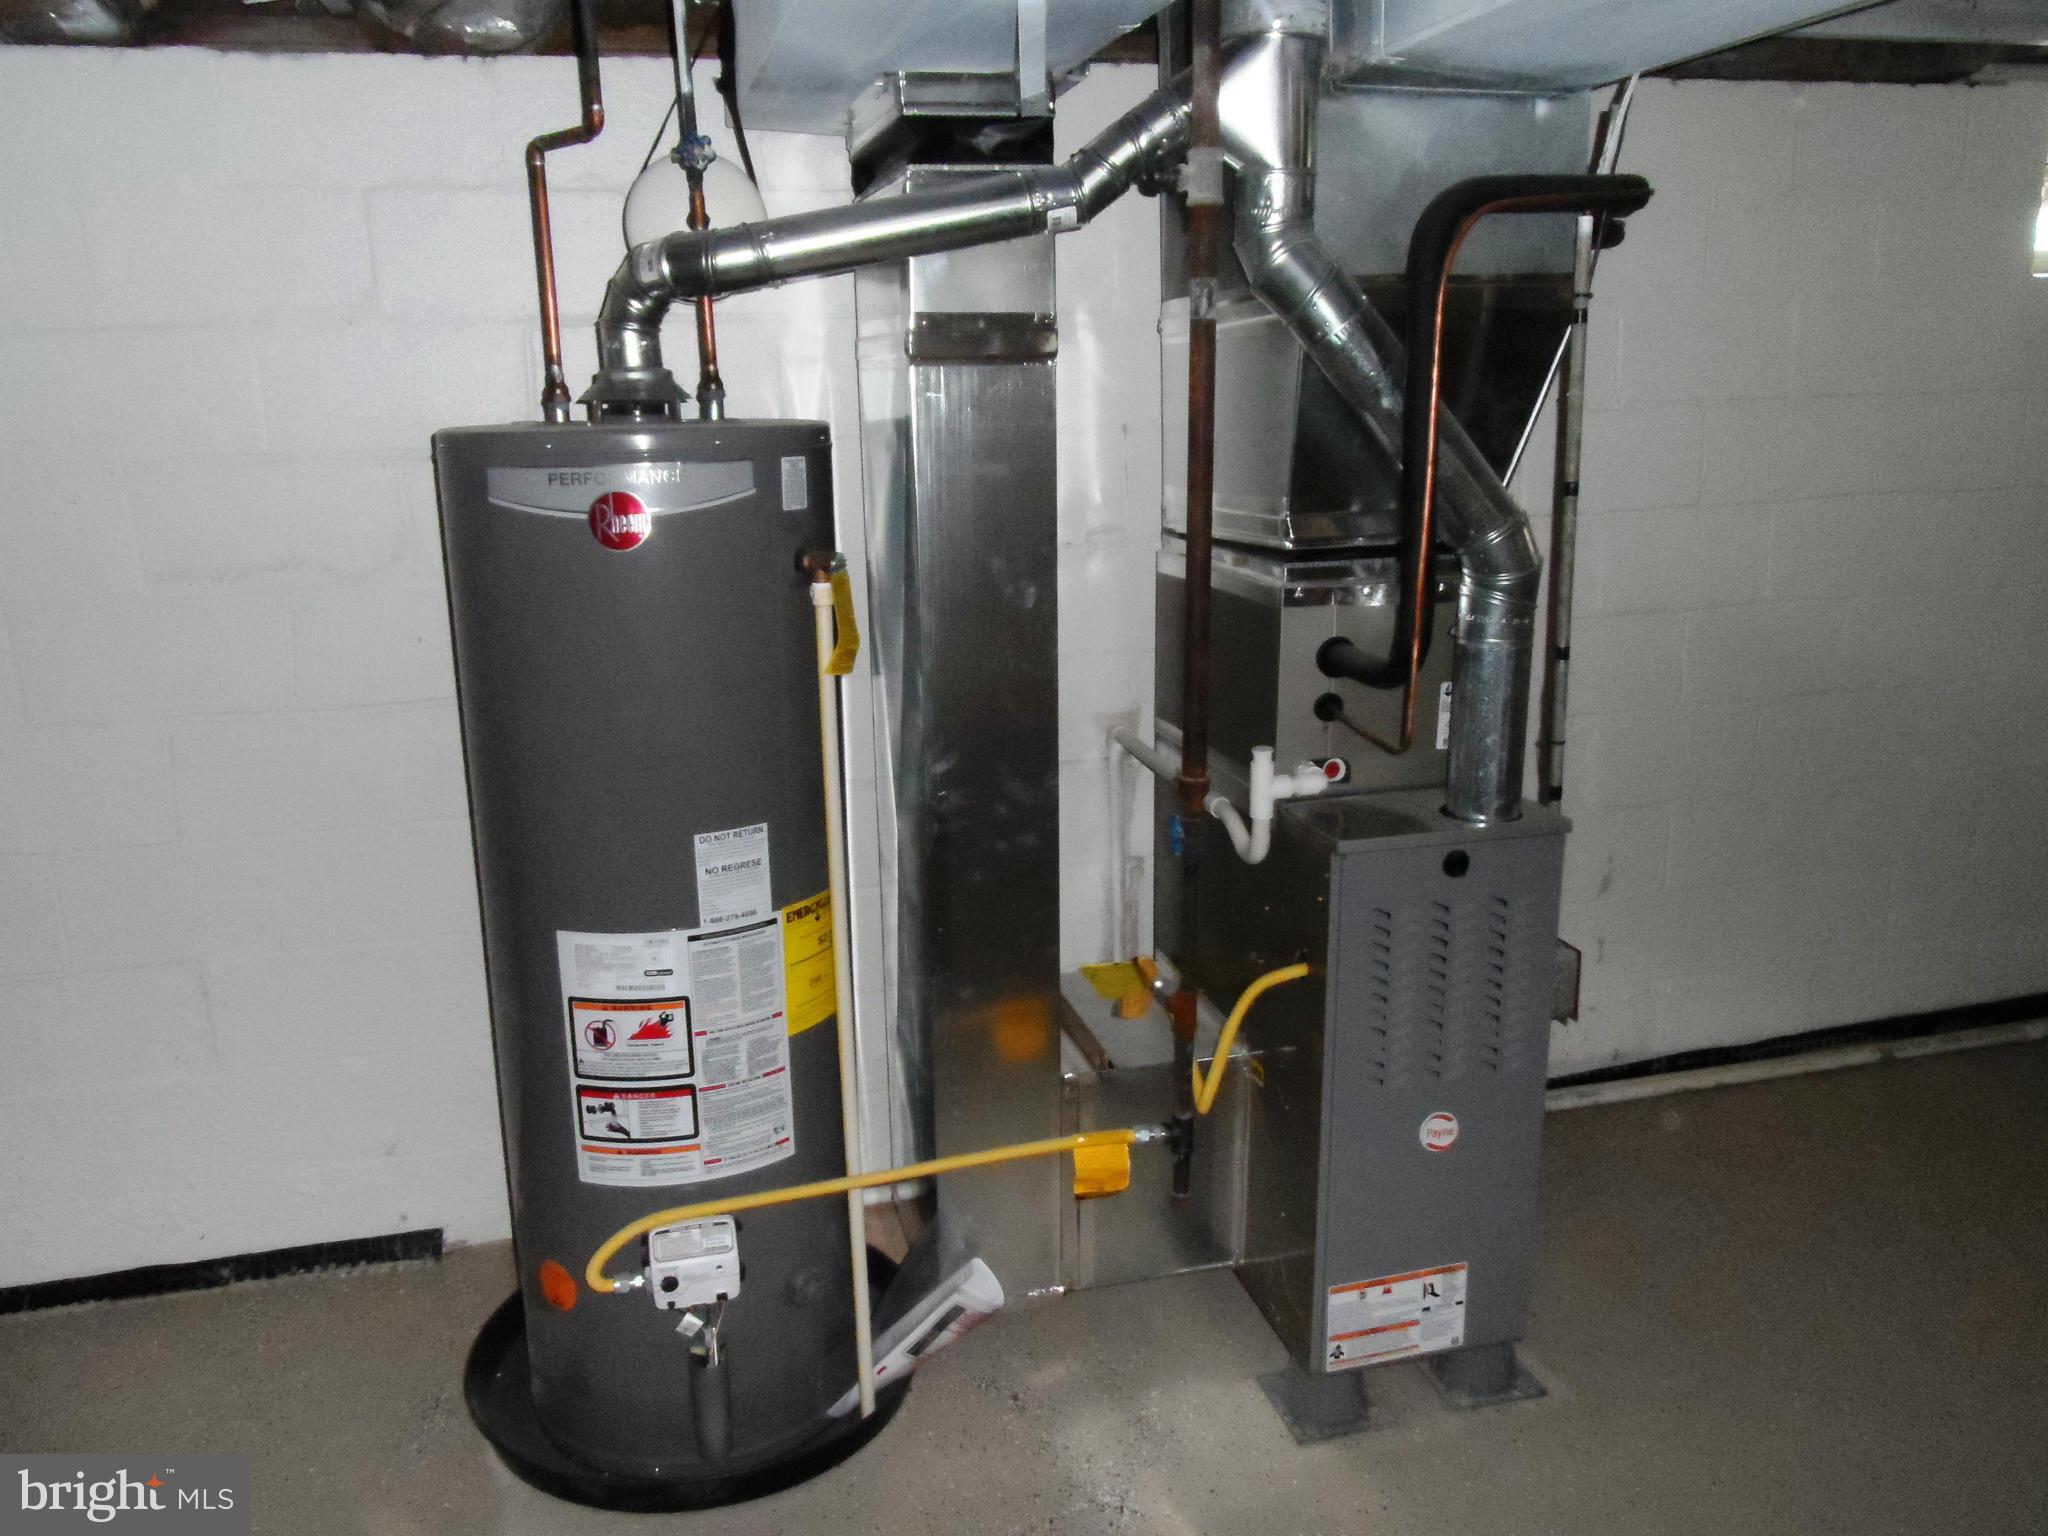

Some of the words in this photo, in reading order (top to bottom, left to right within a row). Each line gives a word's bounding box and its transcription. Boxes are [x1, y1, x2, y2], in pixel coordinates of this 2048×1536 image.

[548, 468, 681, 486] PERFOMANC
[596, 493, 649, 542] Rheem
[699, 835, 712, 844] DO
[714, 832, 730, 841] NOT
[733, 826, 764, 839] RETURN
[705, 866, 719, 875] NO
[721, 858, 762, 872] REGRESE
